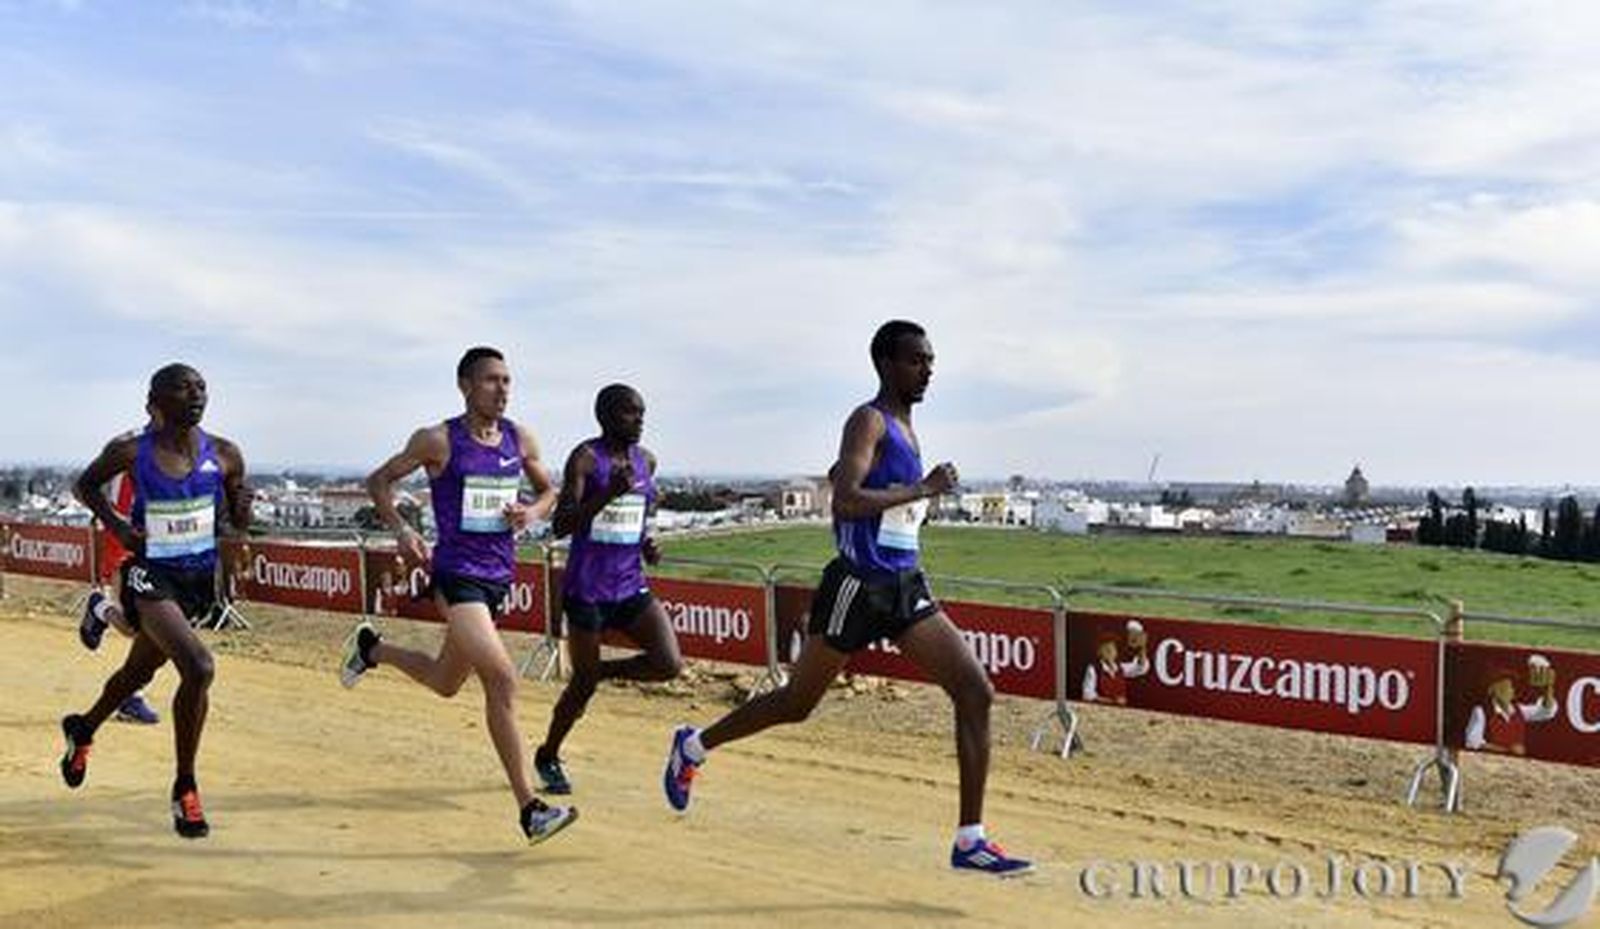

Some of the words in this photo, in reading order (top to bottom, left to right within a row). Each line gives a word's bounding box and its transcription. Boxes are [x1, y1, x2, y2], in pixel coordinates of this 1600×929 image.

[10, 532, 83, 568] Cruzcampo
[255, 554, 351, 595] Cruzcampo
[664, 602, 751, 643] campo
[1154, 637, 1411, 714] Cruzcampo
